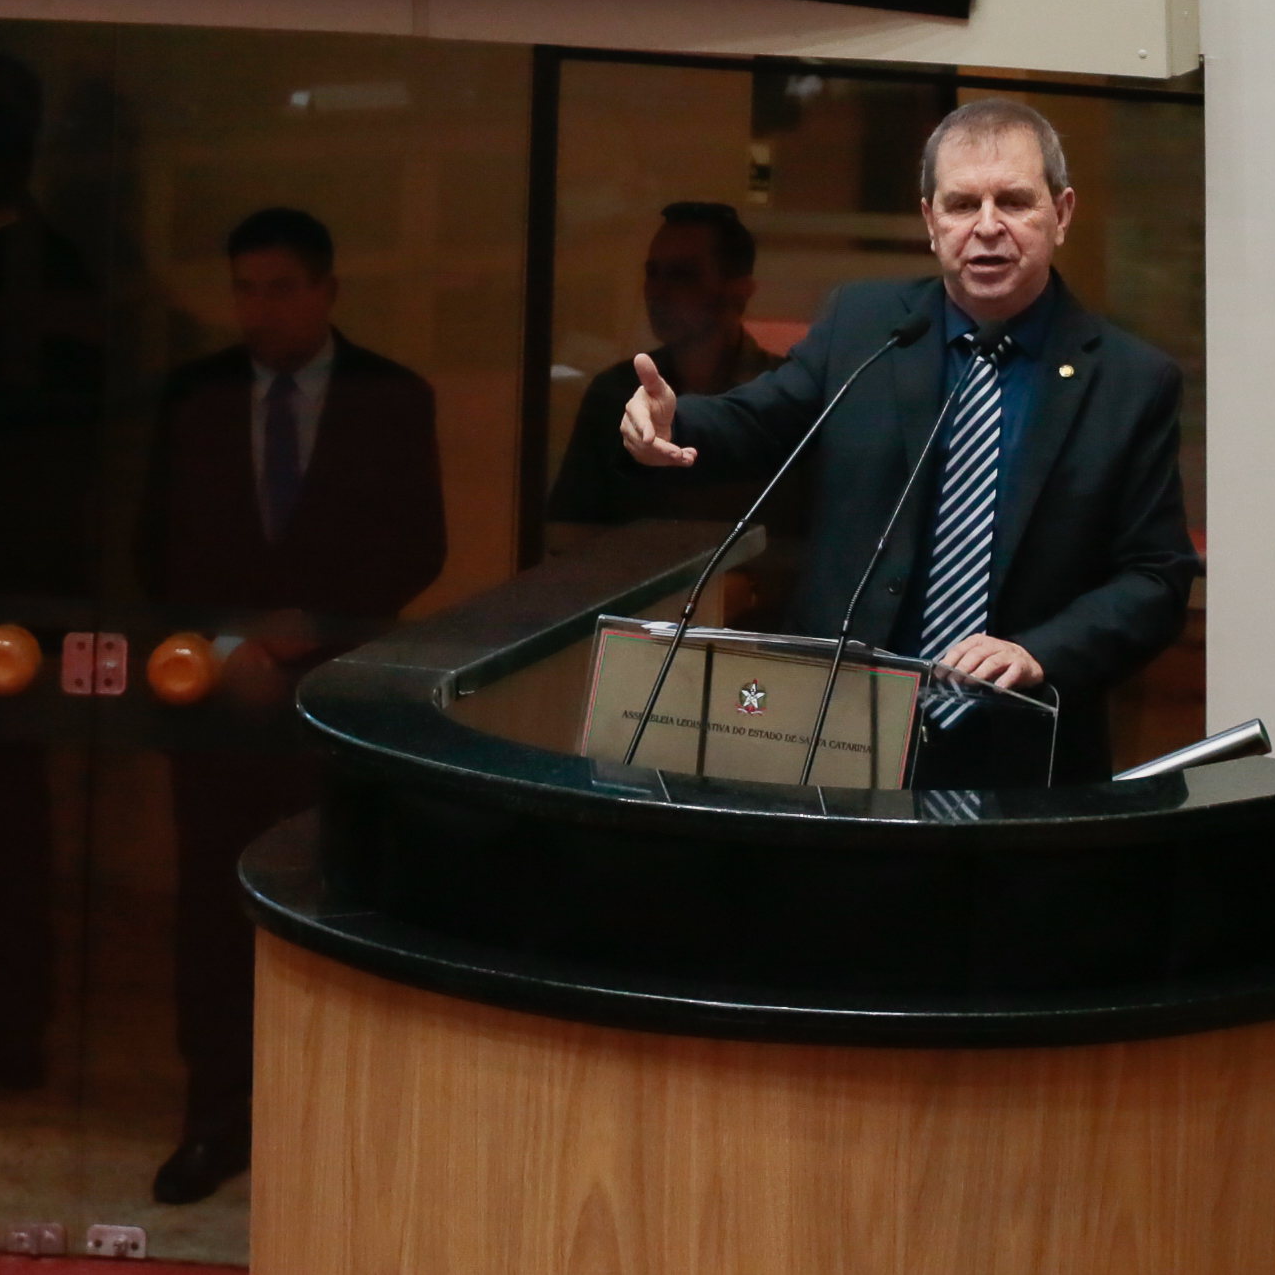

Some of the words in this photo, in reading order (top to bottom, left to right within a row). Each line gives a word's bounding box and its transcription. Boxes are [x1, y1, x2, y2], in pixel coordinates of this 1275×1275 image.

[621, 709, 675, 726] ASSEBLEIA
[676, 718, 731, 733] LEGISATIVA
[732, 726, 746, 736] DO
[747, 727, 783, 742] ESTADO
[784, 733, 797, 743] DE
[799, 735, 827, 748] SATA
[828, 740, 873, 755] CATARINA
